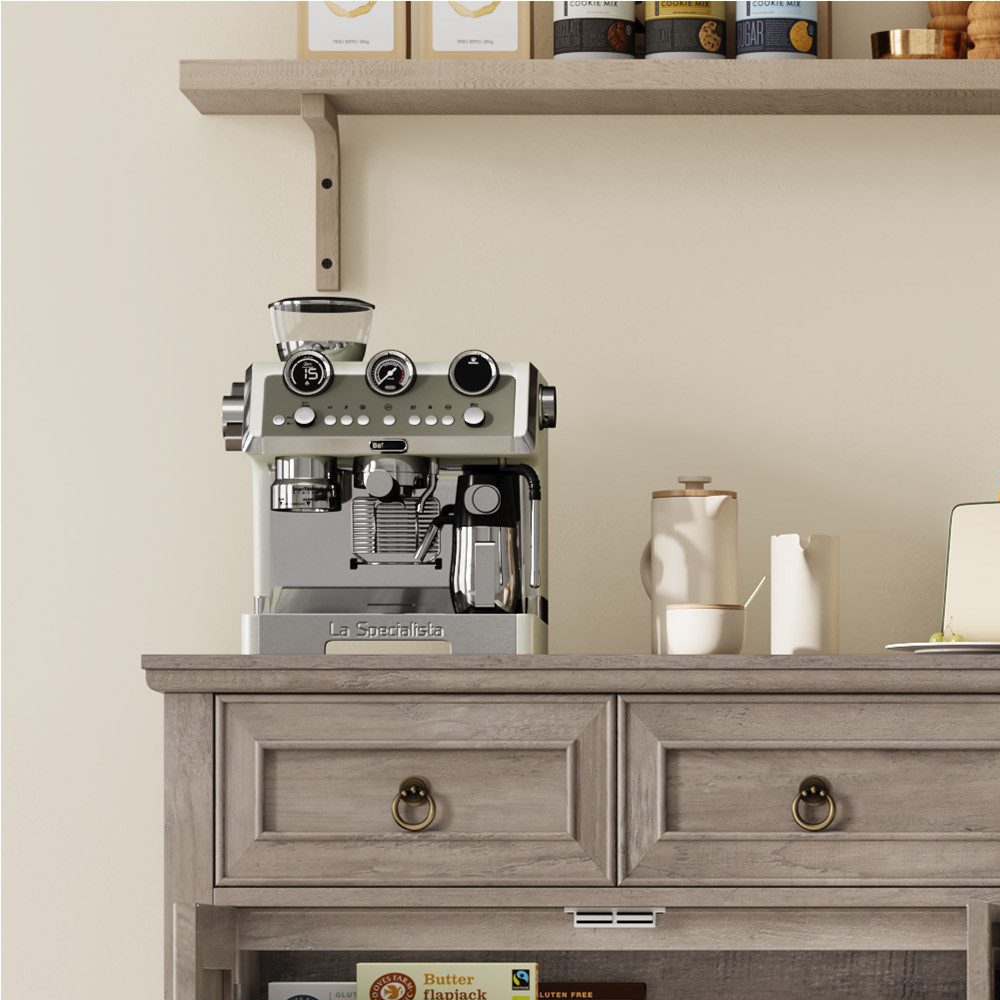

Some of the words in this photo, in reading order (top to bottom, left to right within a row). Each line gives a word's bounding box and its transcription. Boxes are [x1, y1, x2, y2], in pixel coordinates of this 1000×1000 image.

[329, 621, 350, 638] La
[356, 621, 445, 638] Specialista
[423, 973, 474, 986] Butter
[538, 991, 567, 999] LUTEN
[570, 991, 593, 999] FREE
